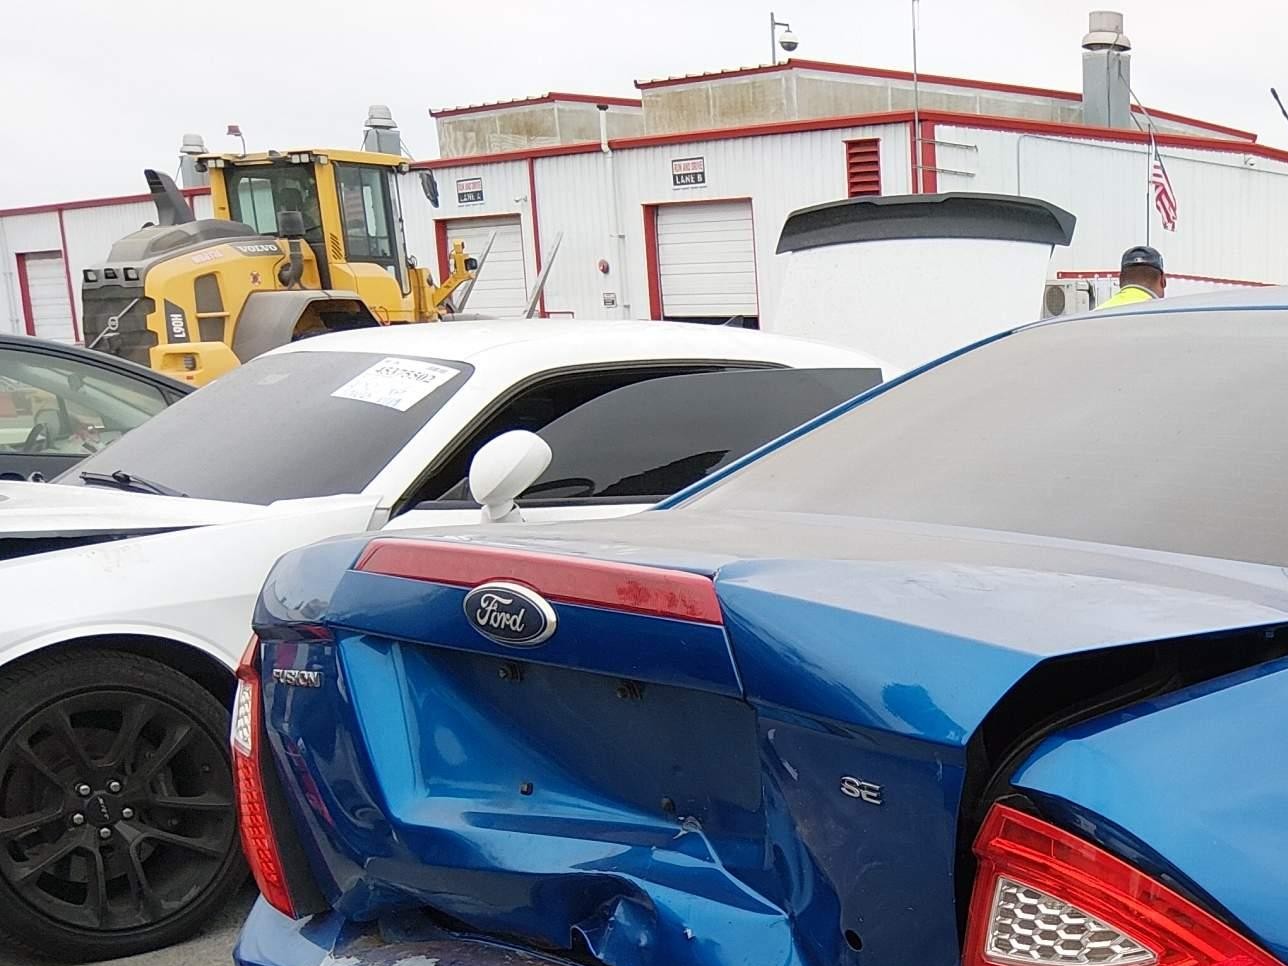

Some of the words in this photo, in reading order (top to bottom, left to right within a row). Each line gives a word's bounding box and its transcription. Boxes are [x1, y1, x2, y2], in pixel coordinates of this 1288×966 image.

[675, 174, 696, 184] LANE
[697, 173, 703, 182] B
[459, 192, 475, 202] LANE
[236, 244, 278, 252] VOLVO
[169, 313, 186, 338] L90H
[476, 593, 526, 632] Ford
[272, 668, 321, 688] FUSION
[840, 776, 882, 805] SE
